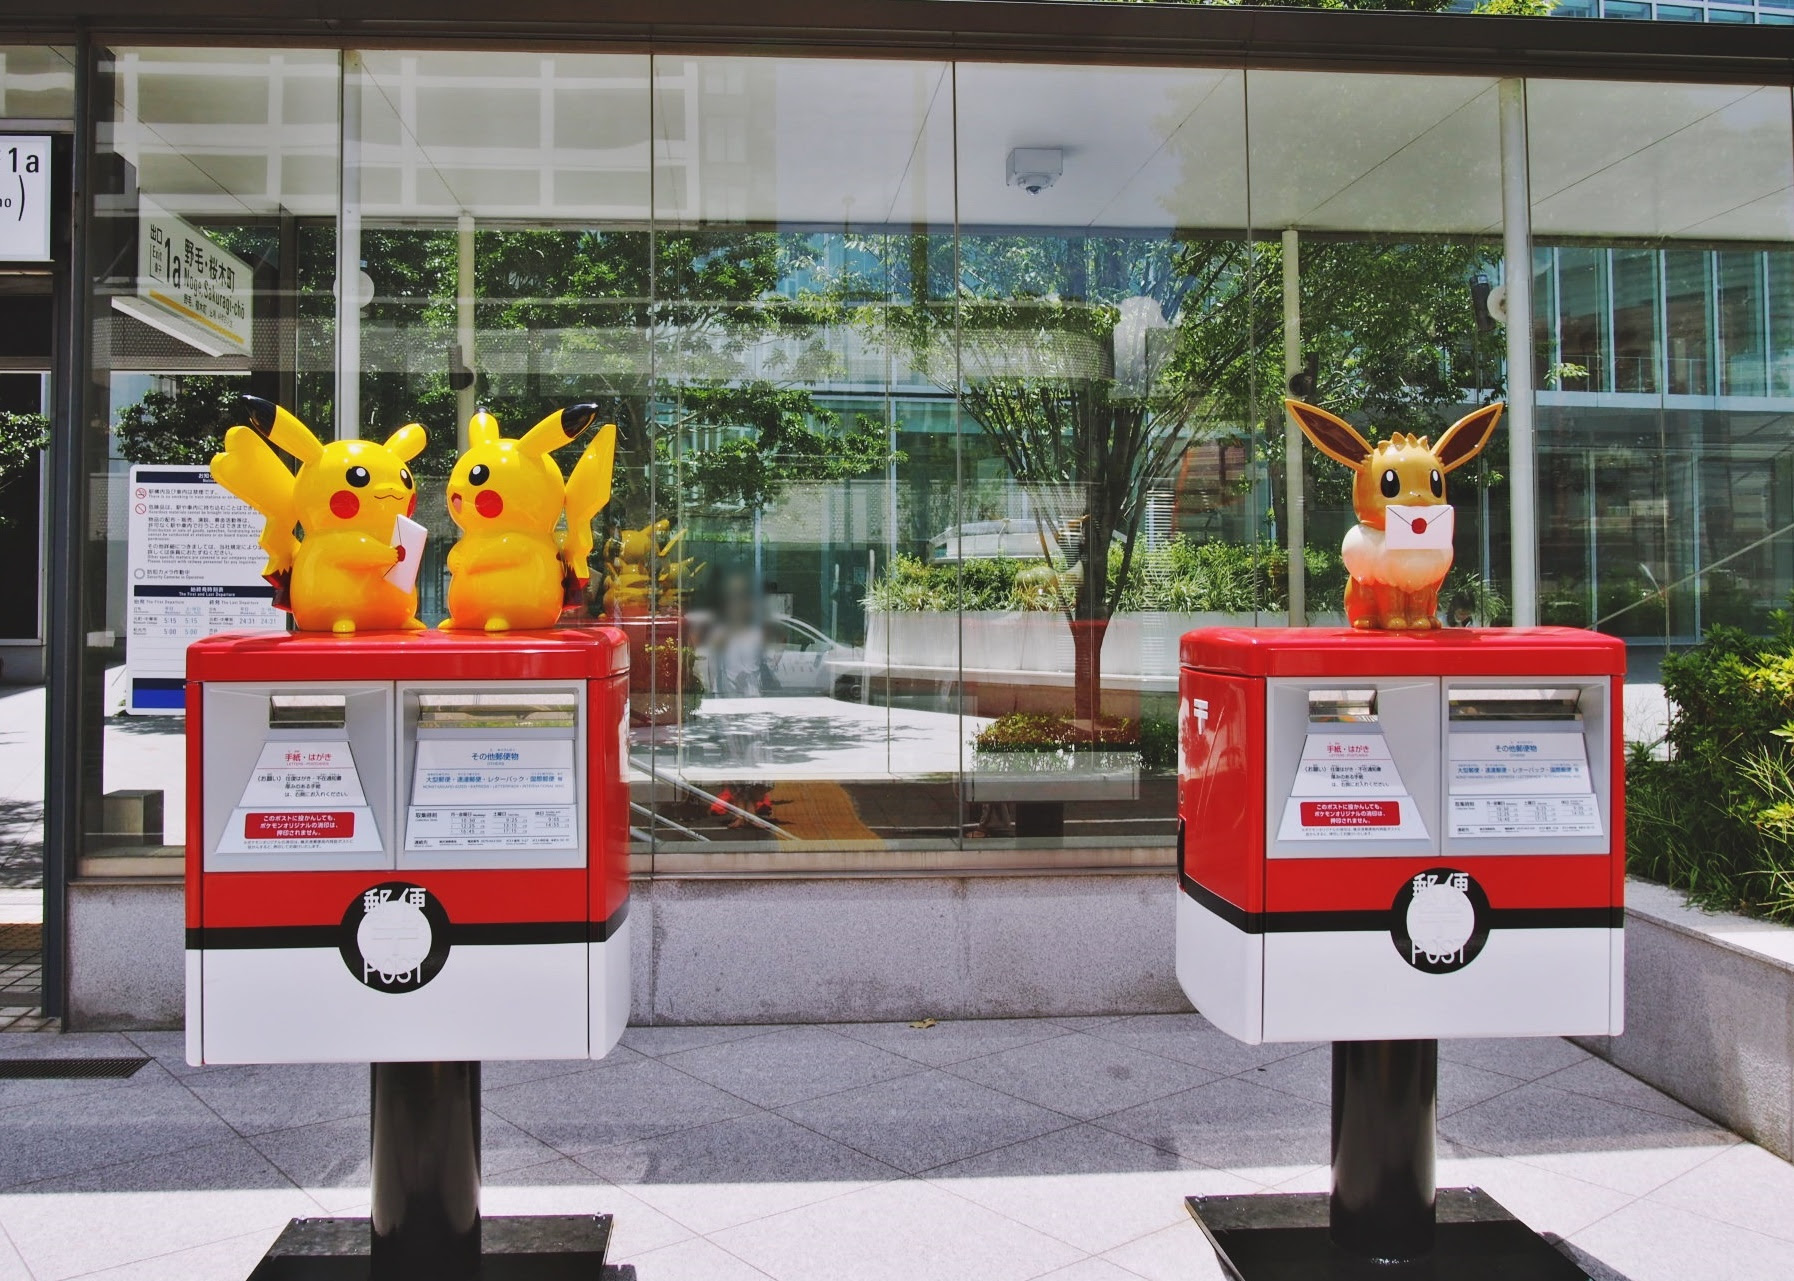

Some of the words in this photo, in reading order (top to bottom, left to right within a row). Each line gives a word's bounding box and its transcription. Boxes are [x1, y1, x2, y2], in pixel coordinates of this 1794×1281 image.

[8, 147, 39, 172] 1a
[150, 224, 162, 244] 出口
[165, 238, 181, 289] 1a
[184, 239, 235, 293] 野毛・桜木町
[1327, 745, 1370, 753] 手紙・はがき
[1495, 745, 1538, 753] その他郵便物
[285, 752, 333, 762] 手紙・はがき
[471, 753, 519, 761] その他郵便物
